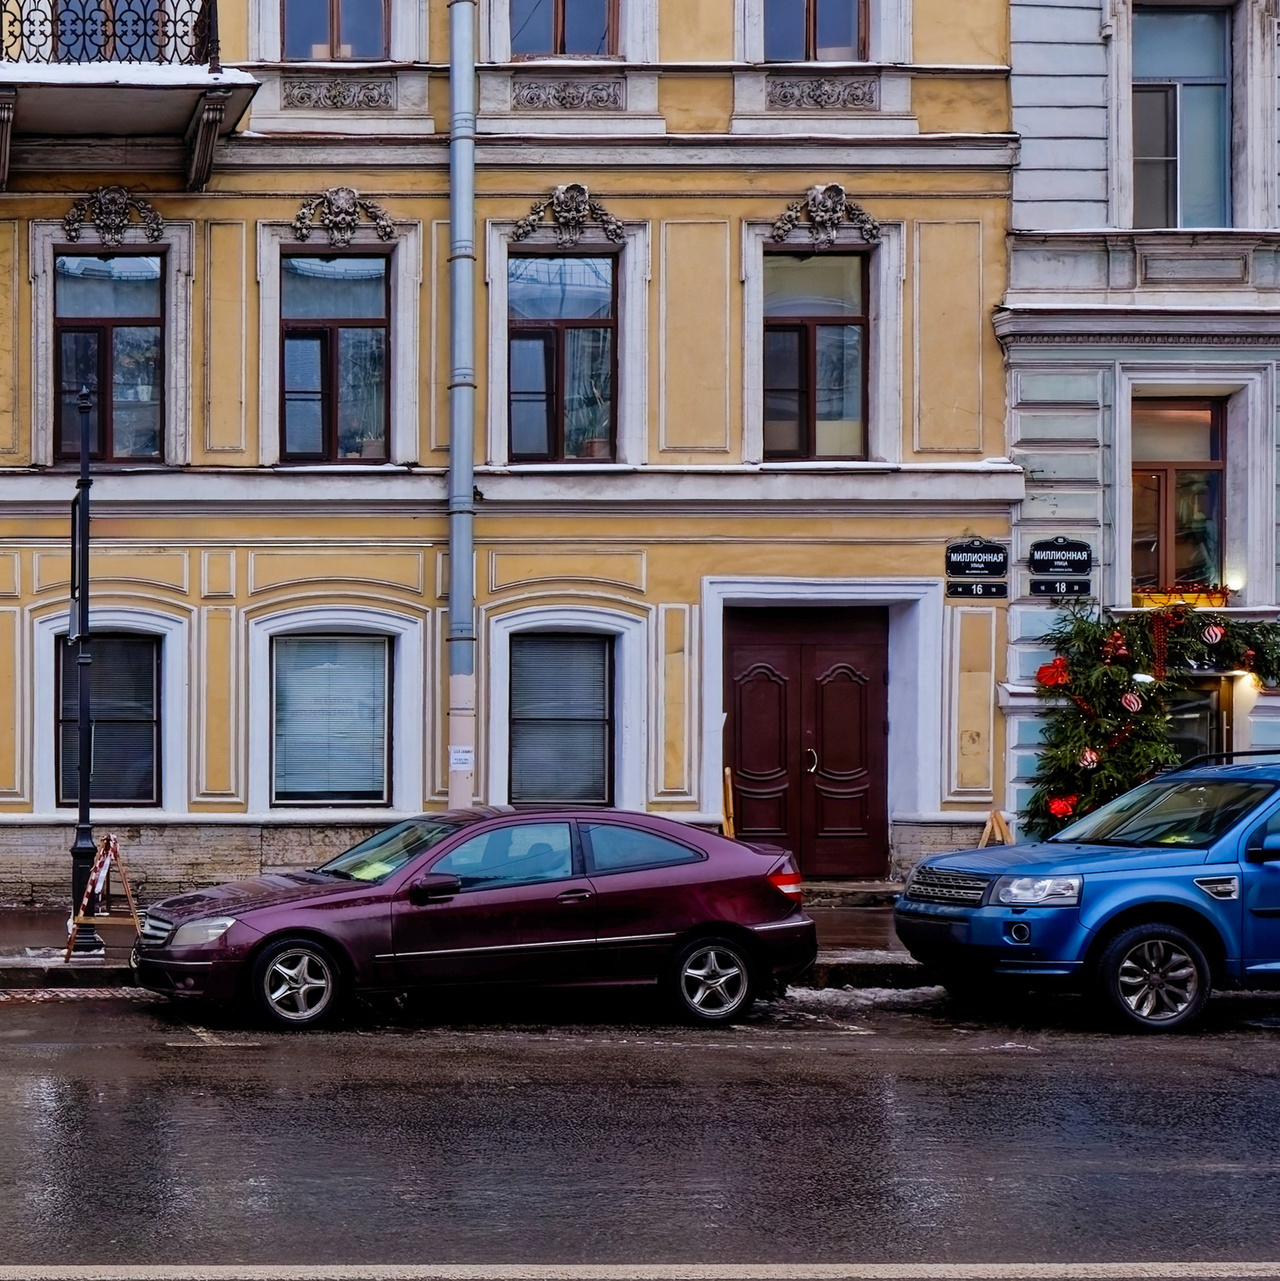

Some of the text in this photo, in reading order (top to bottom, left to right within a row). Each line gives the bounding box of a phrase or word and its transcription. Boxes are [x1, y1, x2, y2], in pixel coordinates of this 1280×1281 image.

[950, 553, 1004, 562] МИЛЛИОННАЯ
[1034, 550, 1088, 560] МИЛЛИОННАЯ
[971, 584, 983, 595] 16
[1055, 582, 1066, 593] 18
